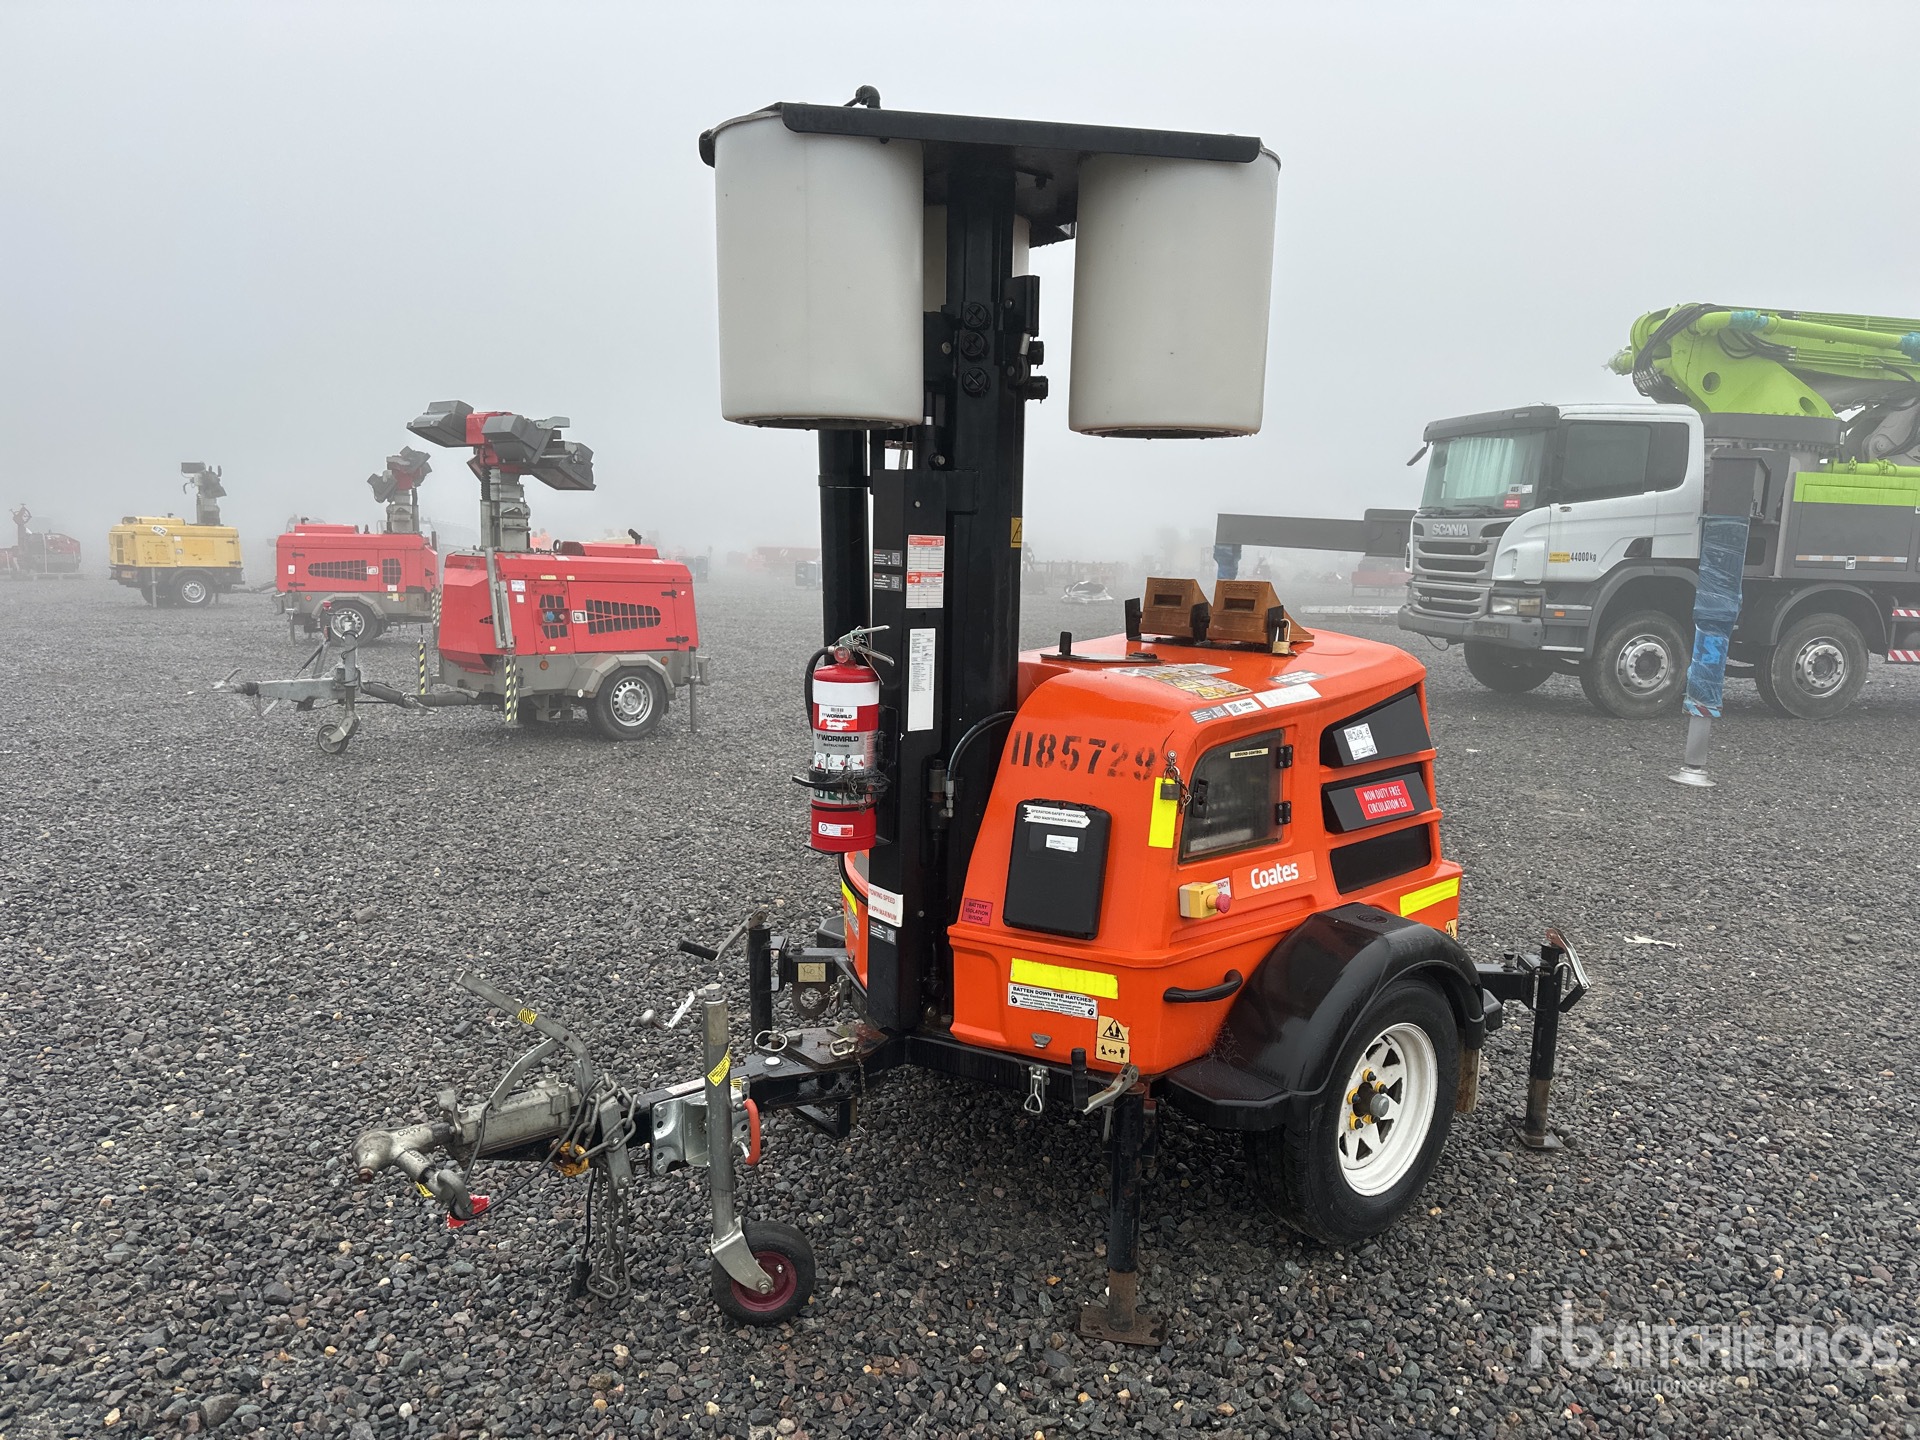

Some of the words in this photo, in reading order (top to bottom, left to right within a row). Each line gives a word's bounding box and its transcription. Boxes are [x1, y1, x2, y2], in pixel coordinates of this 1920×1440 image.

[153, 526, 166, 535] E72
[1432, 524, 1469, 536] SCANIA
[821, 735, 859, 743] WORMALD
[1010, 731, 1156, 781] 1185729
[1363, 790, 1376, 801] NON
[1375, 788, 1389, 800] DUTY
[1389, 785, 1402, 797] FREE
[1367, 800, 1399, 814] CIRCULATION
[1399, 797, 1407, 808] EU
[1250, 862, 1299, 890] Coates
[969, 902, 987, 910] BATTERY
[965, 908, 989, 916] ISOLATION
[1012, 986, 1034, 994] BATTEN
